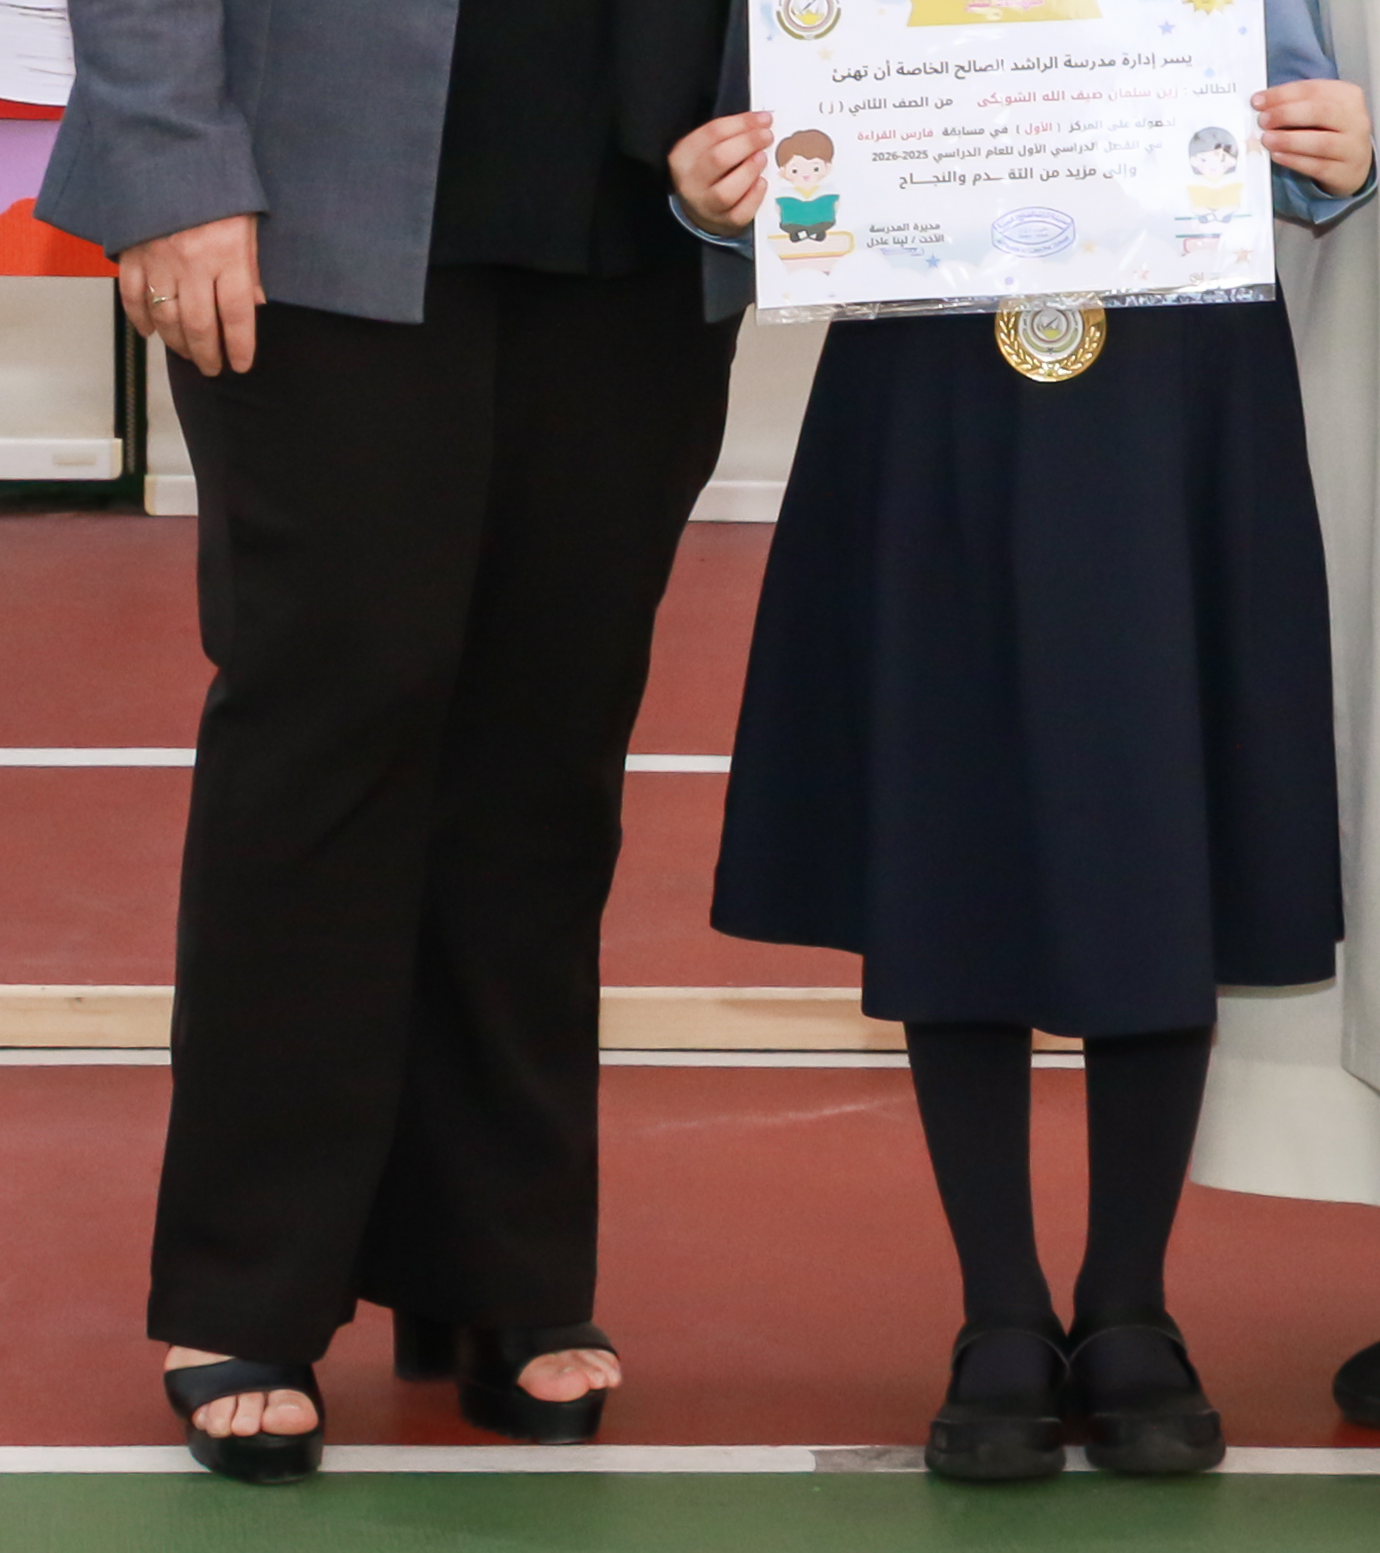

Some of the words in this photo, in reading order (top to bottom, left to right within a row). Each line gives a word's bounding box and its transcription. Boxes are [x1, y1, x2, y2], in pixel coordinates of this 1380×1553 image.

[1010, 55, 1059, 73] الراشد
[1063, 53, 1117, 71] مدرسة
[1122, 52, 1156, 70] إدارة
[1160, 53, 1193, 68] يسر
[873, 59, 892, 81] أن
[896, 61, 949, 76] الخاصة
[954, 58, 1005, 80] الصالح
[892, 96, 929, 109] الصف
[1041, 89, 1066, 102] الله
[848, 97, 888, 117] الثاني
[934, 98, 954, 110] من
[901, 130, 934, 142] فارس
[941, 126, 985, 138] مسابقة
[989, 125, 1009, 138] في
[932, 147, 982, 164] الدراسي
[985, 145, 1015, 159] للعام
[1018, 142, 1047, 158] الأول
[1039, 169, 1060, 182] من
[1065, 166, 1097, 181] مزيد
[868, 223, 910, 235] المدرسة
